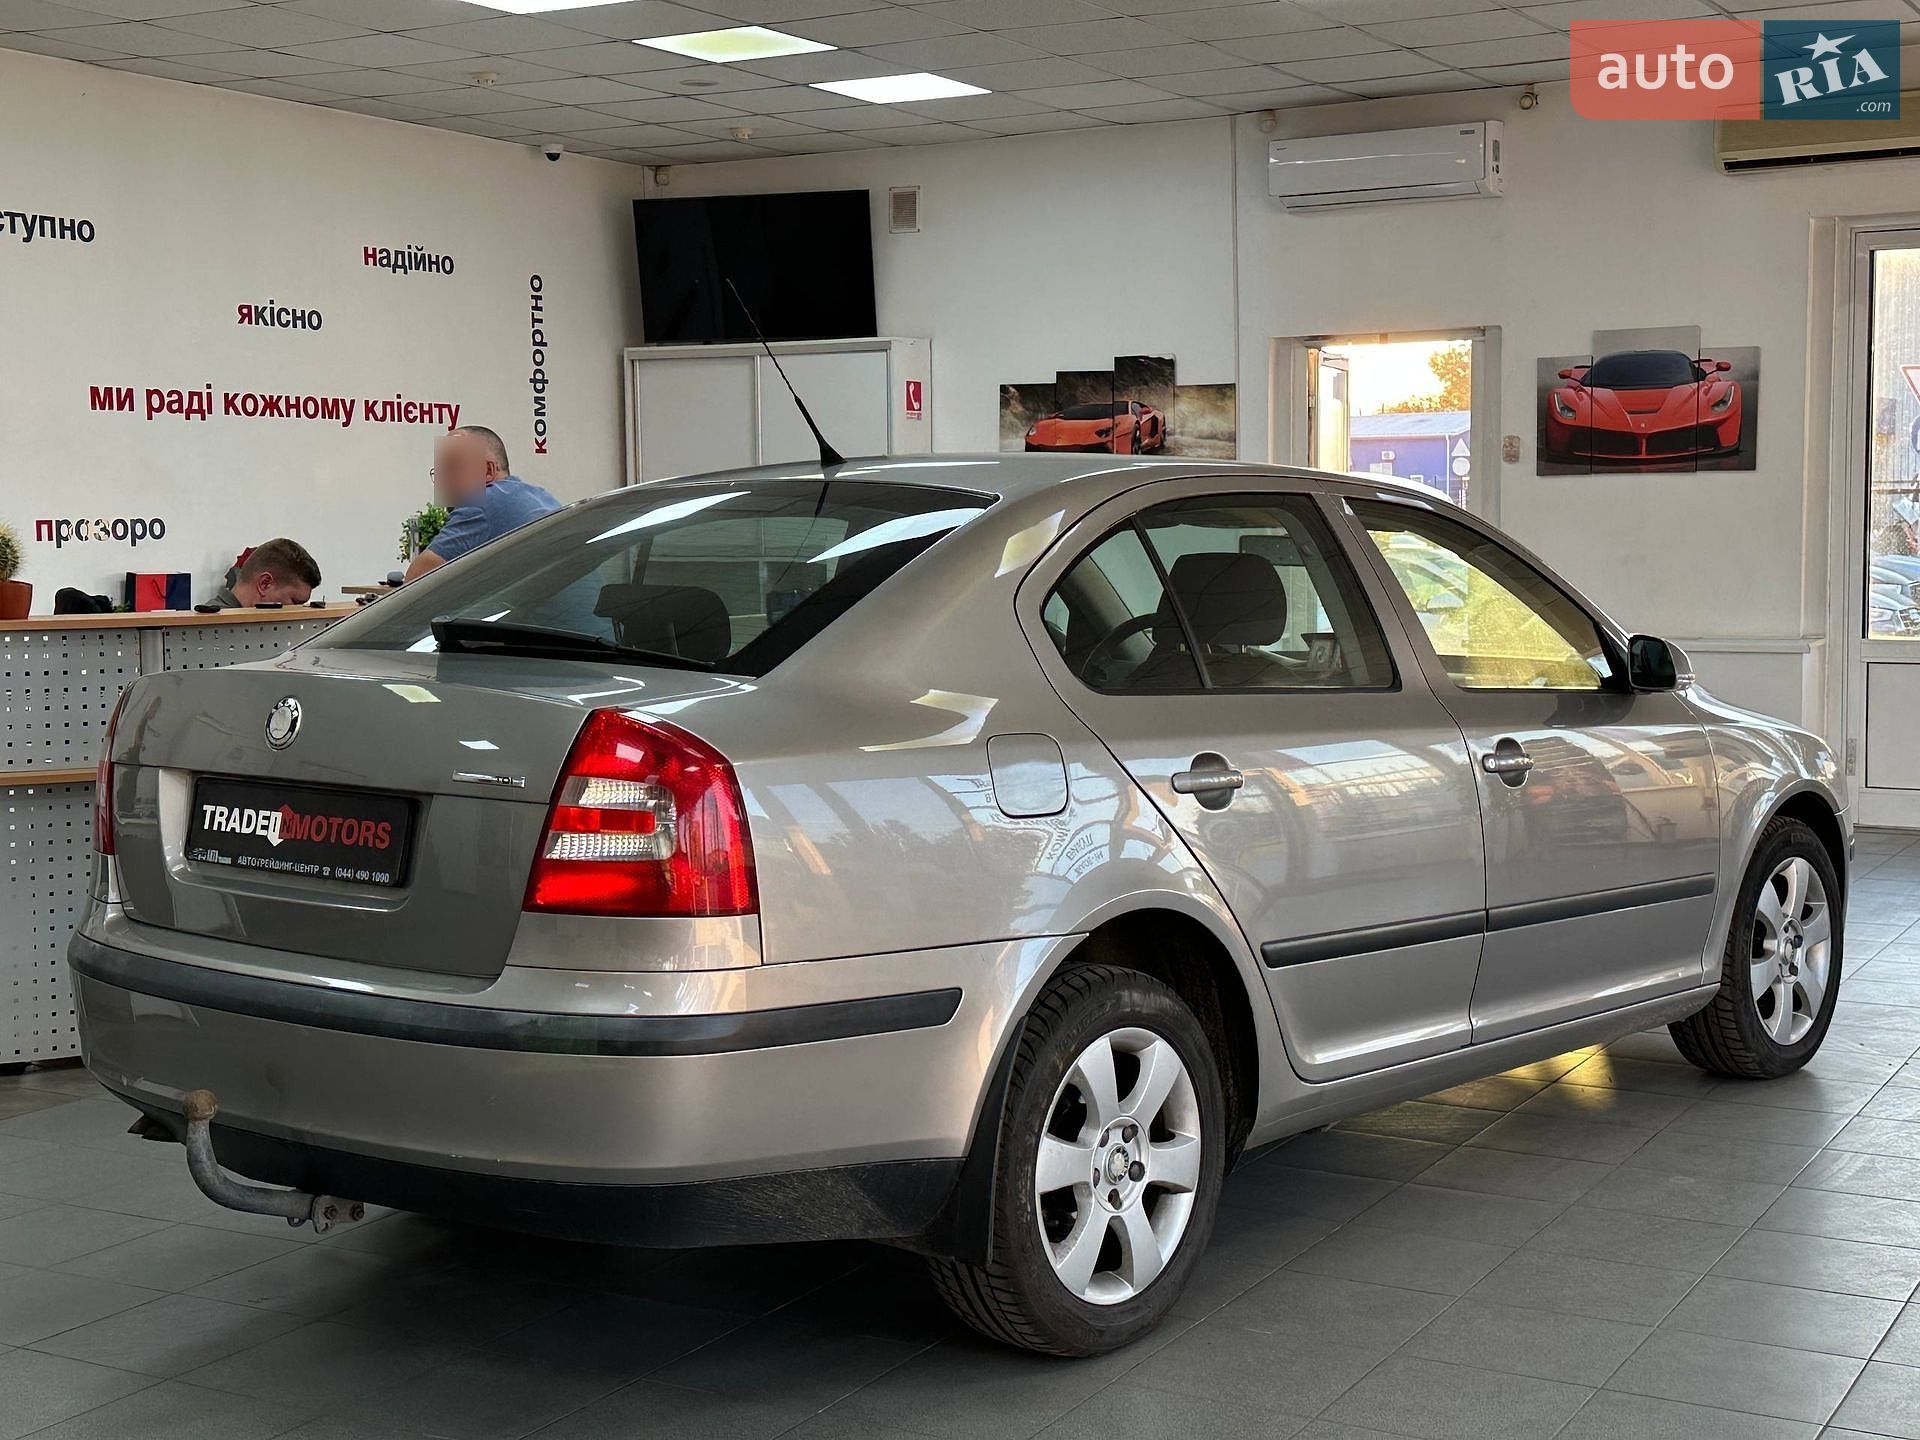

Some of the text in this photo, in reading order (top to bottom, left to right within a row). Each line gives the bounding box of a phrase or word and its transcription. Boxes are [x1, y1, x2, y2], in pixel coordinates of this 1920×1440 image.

[0, 210, 96, 244] тупно
[363, 244, 455, 276] надійно
[237, 299, 323, 331] якісно
[529, 273, 550, 455] комфортно
[89, 383, 461, 429] ми раді кожному клієнту
[35, 517, 166, 549] прозоро
